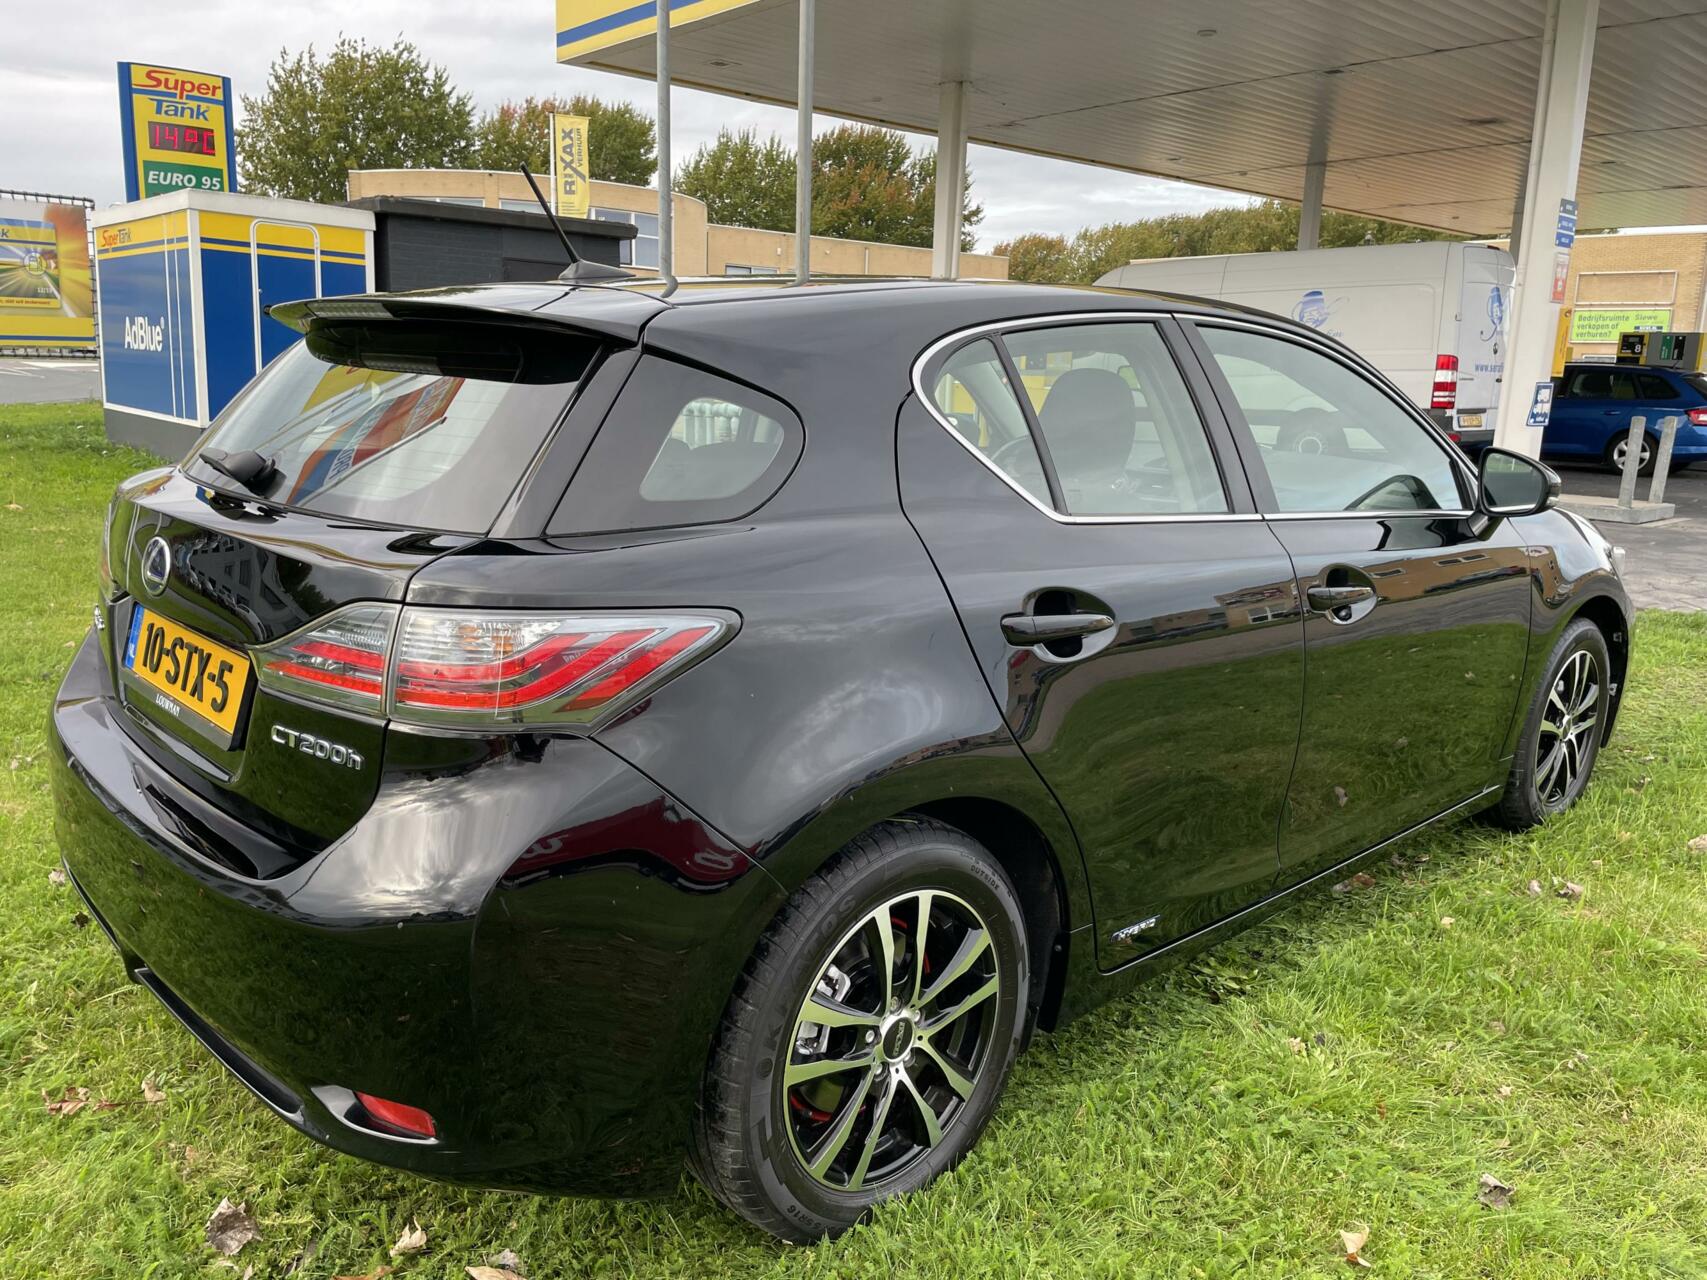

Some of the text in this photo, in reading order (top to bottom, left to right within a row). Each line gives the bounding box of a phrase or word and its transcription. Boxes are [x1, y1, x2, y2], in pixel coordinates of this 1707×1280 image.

[132, 69, 222, 100] Super
[147, 97, 209, 121] Tank
[147, 171, 222, 190] EURO 95
[1576, 322, 1620, 331] verkopen of
[1578, 314, 1630, 322] Bedrijfsruimte
[124, 316, 164, 352] AdBlue
[1634, 344, 1642, 353] 8
[142, 622, 234, 714] 10-STX-5
[271, 724, 365, 771] CT200h
